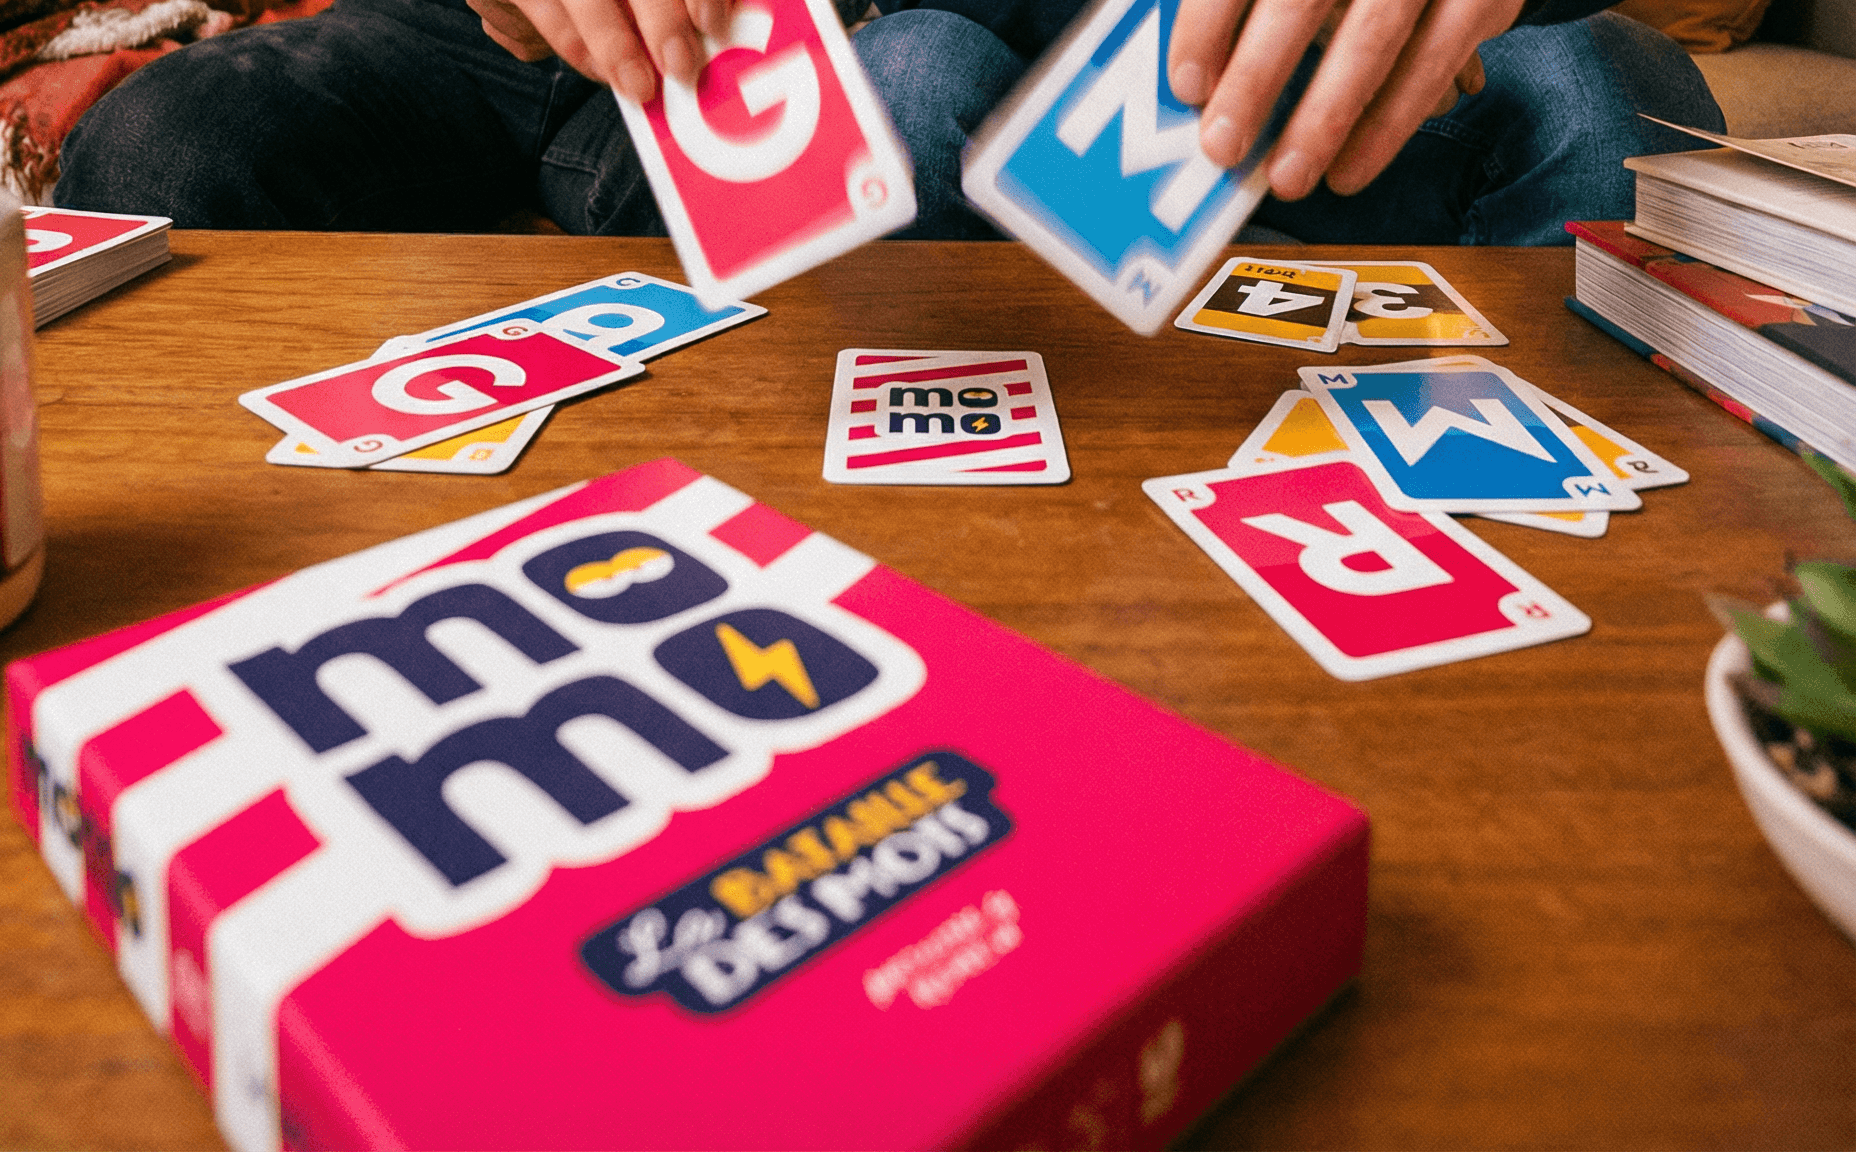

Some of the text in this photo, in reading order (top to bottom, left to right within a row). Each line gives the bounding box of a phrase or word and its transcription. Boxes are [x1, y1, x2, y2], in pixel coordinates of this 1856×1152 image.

[662, 2, 821, 182] G
[1237, 279, 1326, 317] 4
[1352, 281, 1434, 319] 3
[371, 353, 527, 416] G
[1317, 373, 1349, 385] M
[1240, 499, 1456, 596] R
[678, 892, 831, 1006] DES
